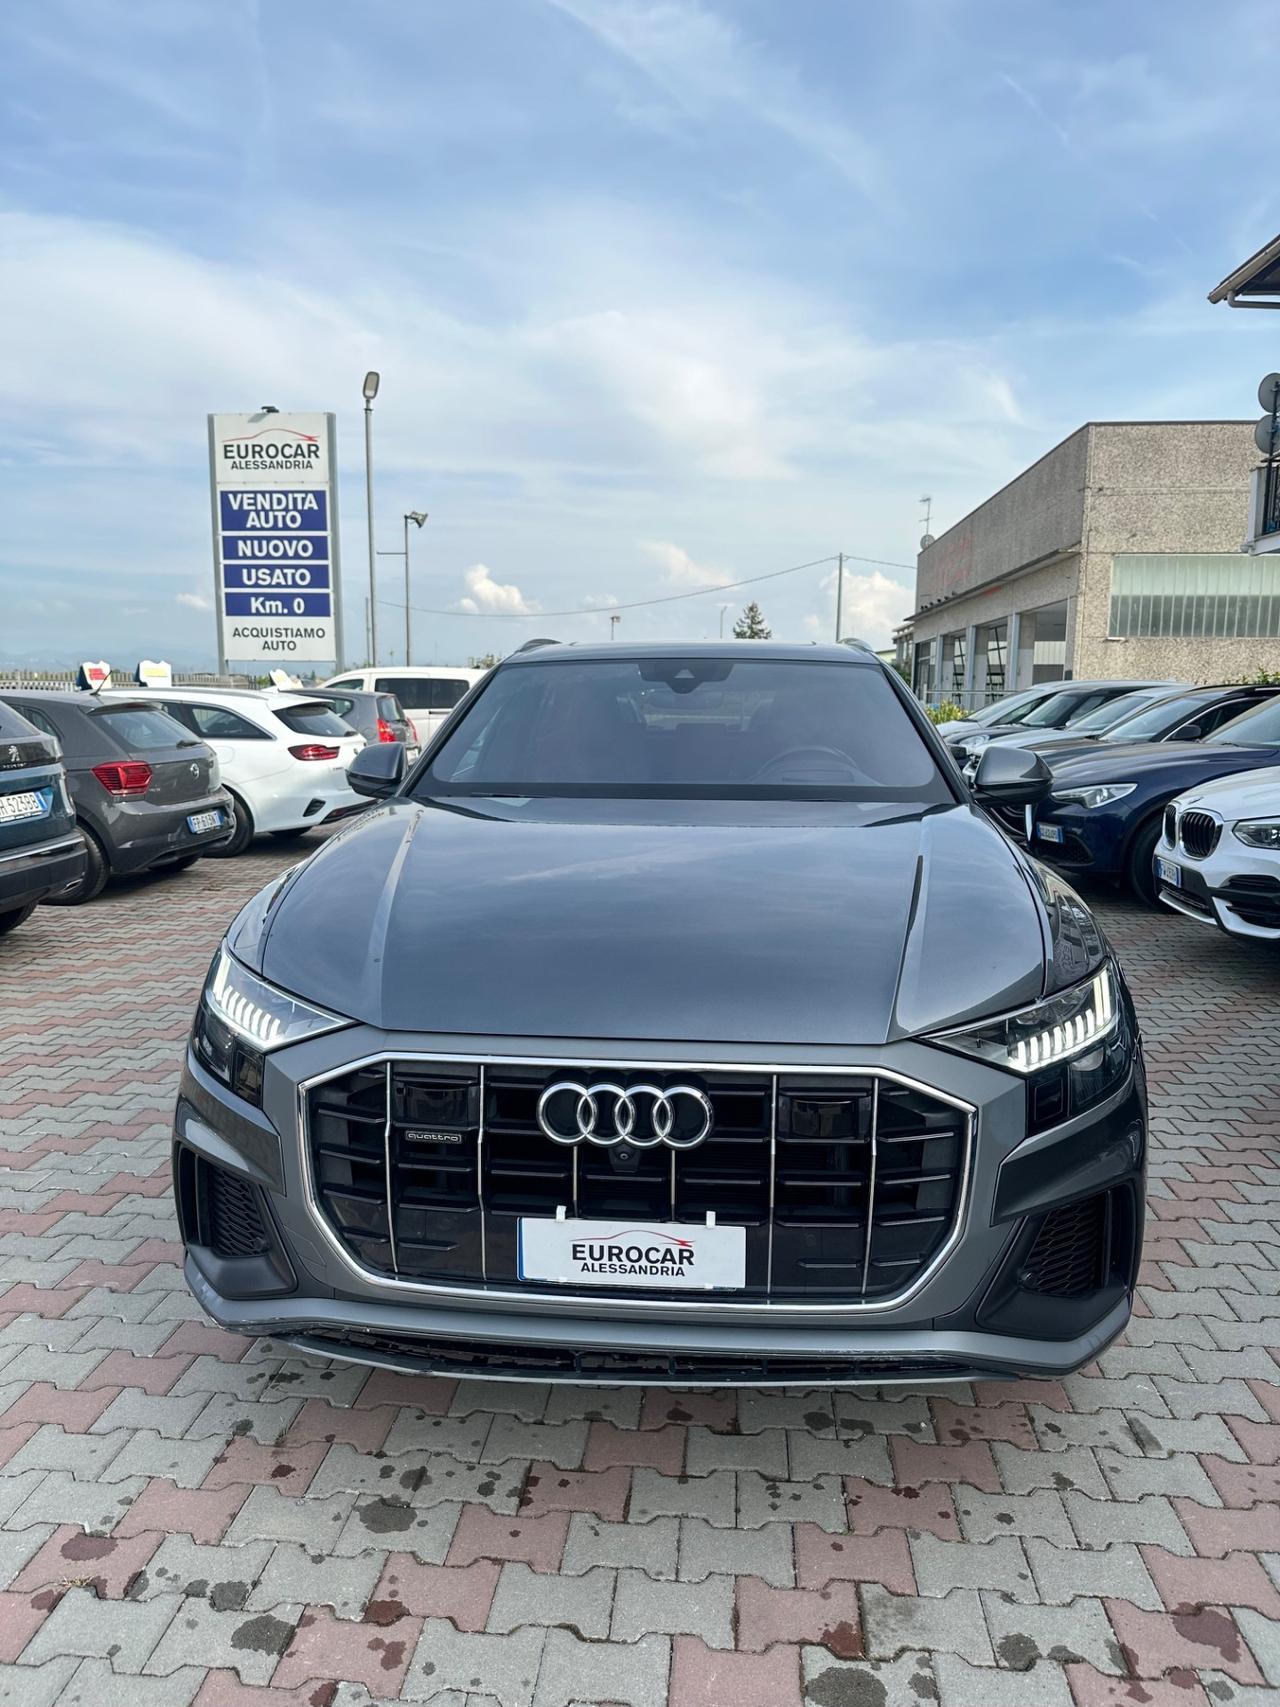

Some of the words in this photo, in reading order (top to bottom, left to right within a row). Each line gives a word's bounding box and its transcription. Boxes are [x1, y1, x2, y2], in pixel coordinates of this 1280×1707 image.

[223, 443, 320, 460] EUROCAR
[230, 460, 313, 470] ALESSANDRIA
[228, 493, 318, 511] VENDITA
[246, 511, 302, 528] AUTO
[237, 540, 313, 557] NUOVO
[242, 568, 311, 586] USATO
[250, 597, 288, 614] Km.
[293, 597, 305, 614] 0
[232, 627, 326, 639] ACQUISTIAMO
[262, 640, 297, 651] AUTO
[408, 1133, 459, 1142] quattro
[572, 1243, 695, 1266] EUROCAR
[580, 1263, 685, 1277] ALESSANDRIA
